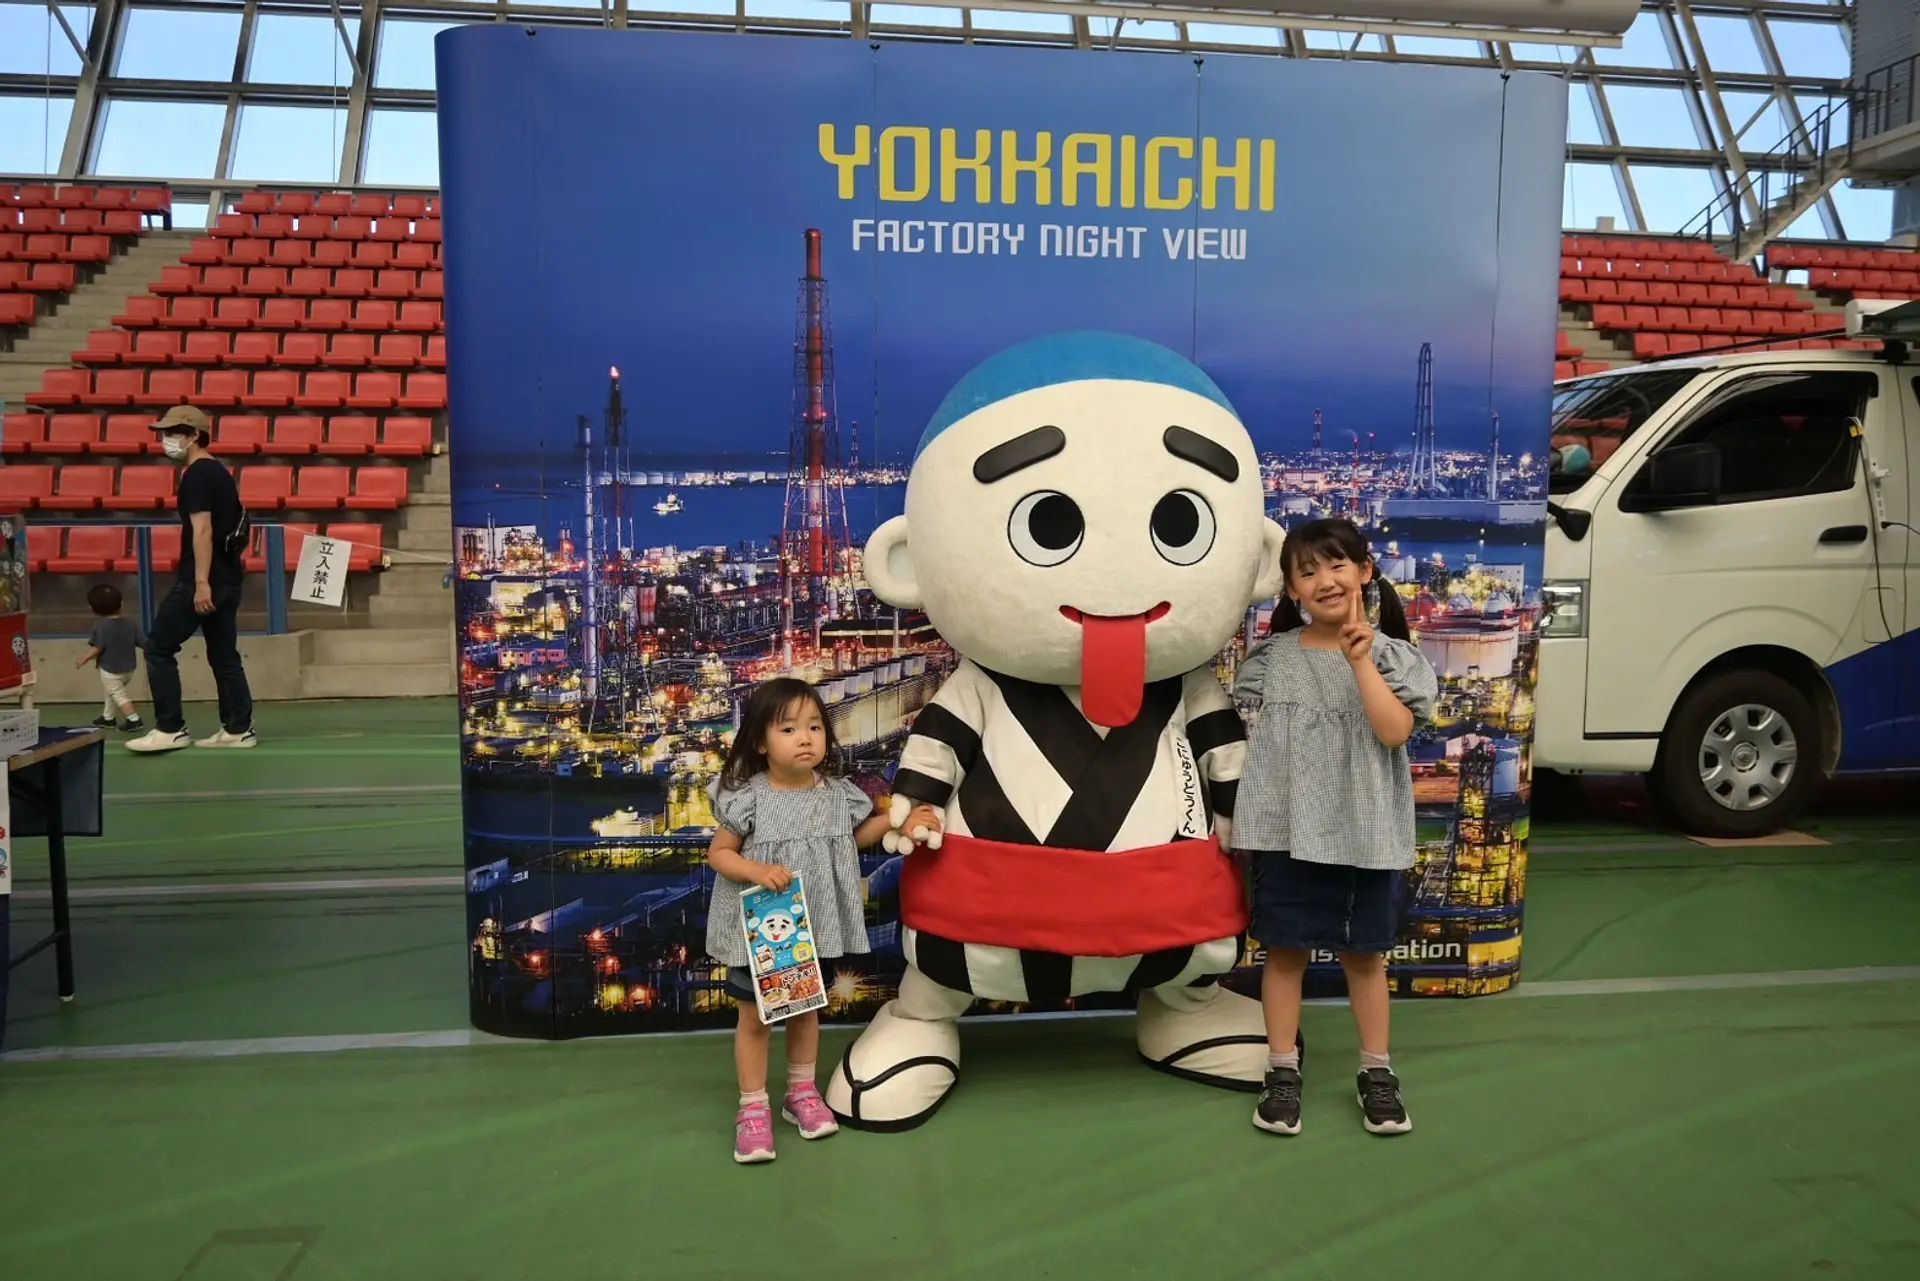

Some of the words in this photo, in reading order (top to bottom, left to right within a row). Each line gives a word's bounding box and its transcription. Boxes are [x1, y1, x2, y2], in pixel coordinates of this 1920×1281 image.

[818, 123, 1275, 212] YOKKAICHI
[852, 219, 1025, 256] FACTORY
[1039, 224, 1147, 259] NIGHT
[1162, 228, 1247, 260] VIEW
[309, 541, 334, 599] 立入禁止
